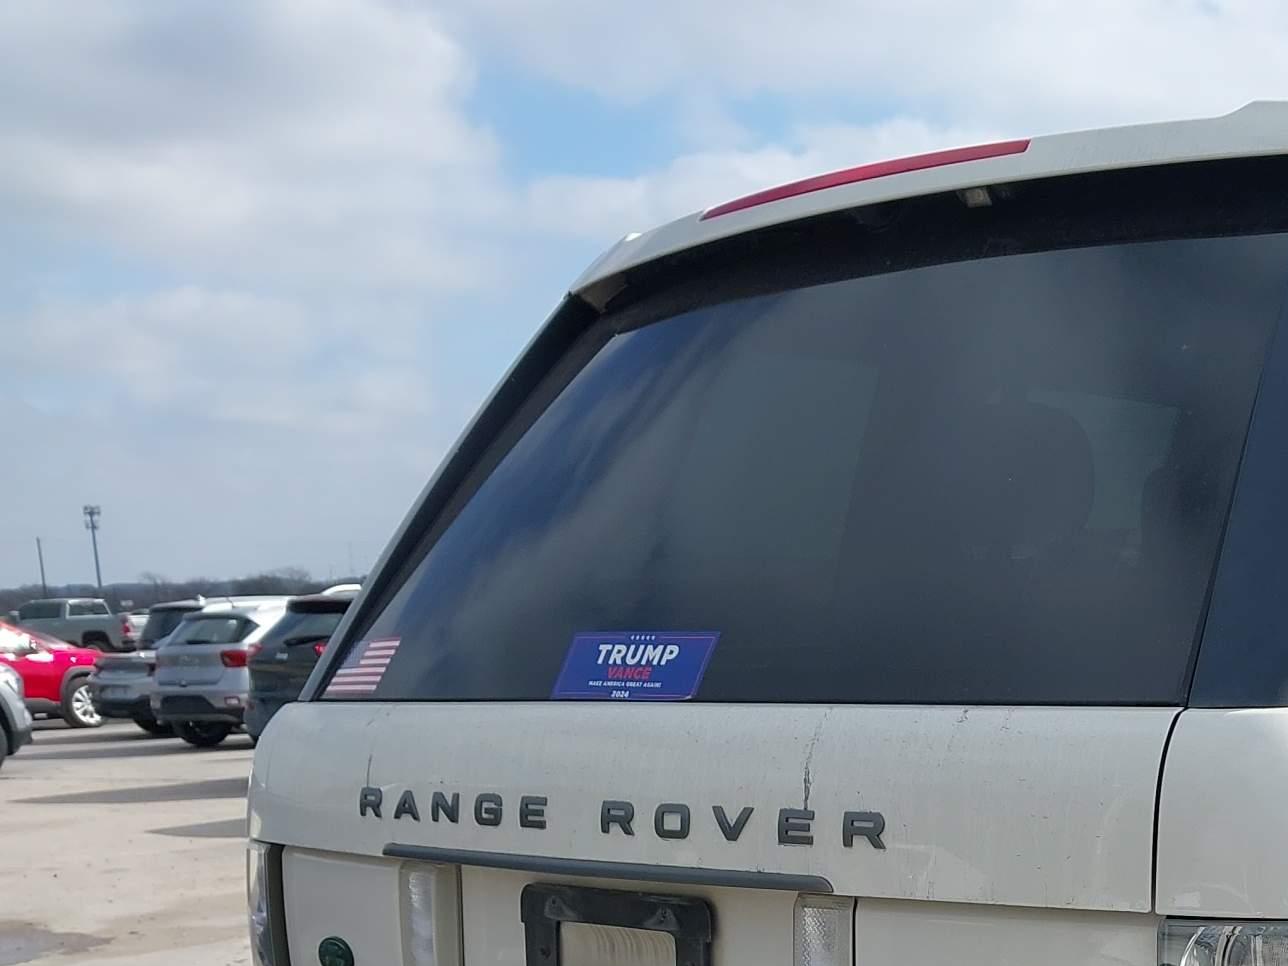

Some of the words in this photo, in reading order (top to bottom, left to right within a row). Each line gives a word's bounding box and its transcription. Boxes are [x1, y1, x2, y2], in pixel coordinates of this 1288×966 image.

[597, 644, 680, 666] TRUMP
[607, 667, 652, 680] VANCE
[611, 690, 630, 698] 2024
[359, 786, 548, 830] RANGE
[600, 800, 888, 850] ROVER
